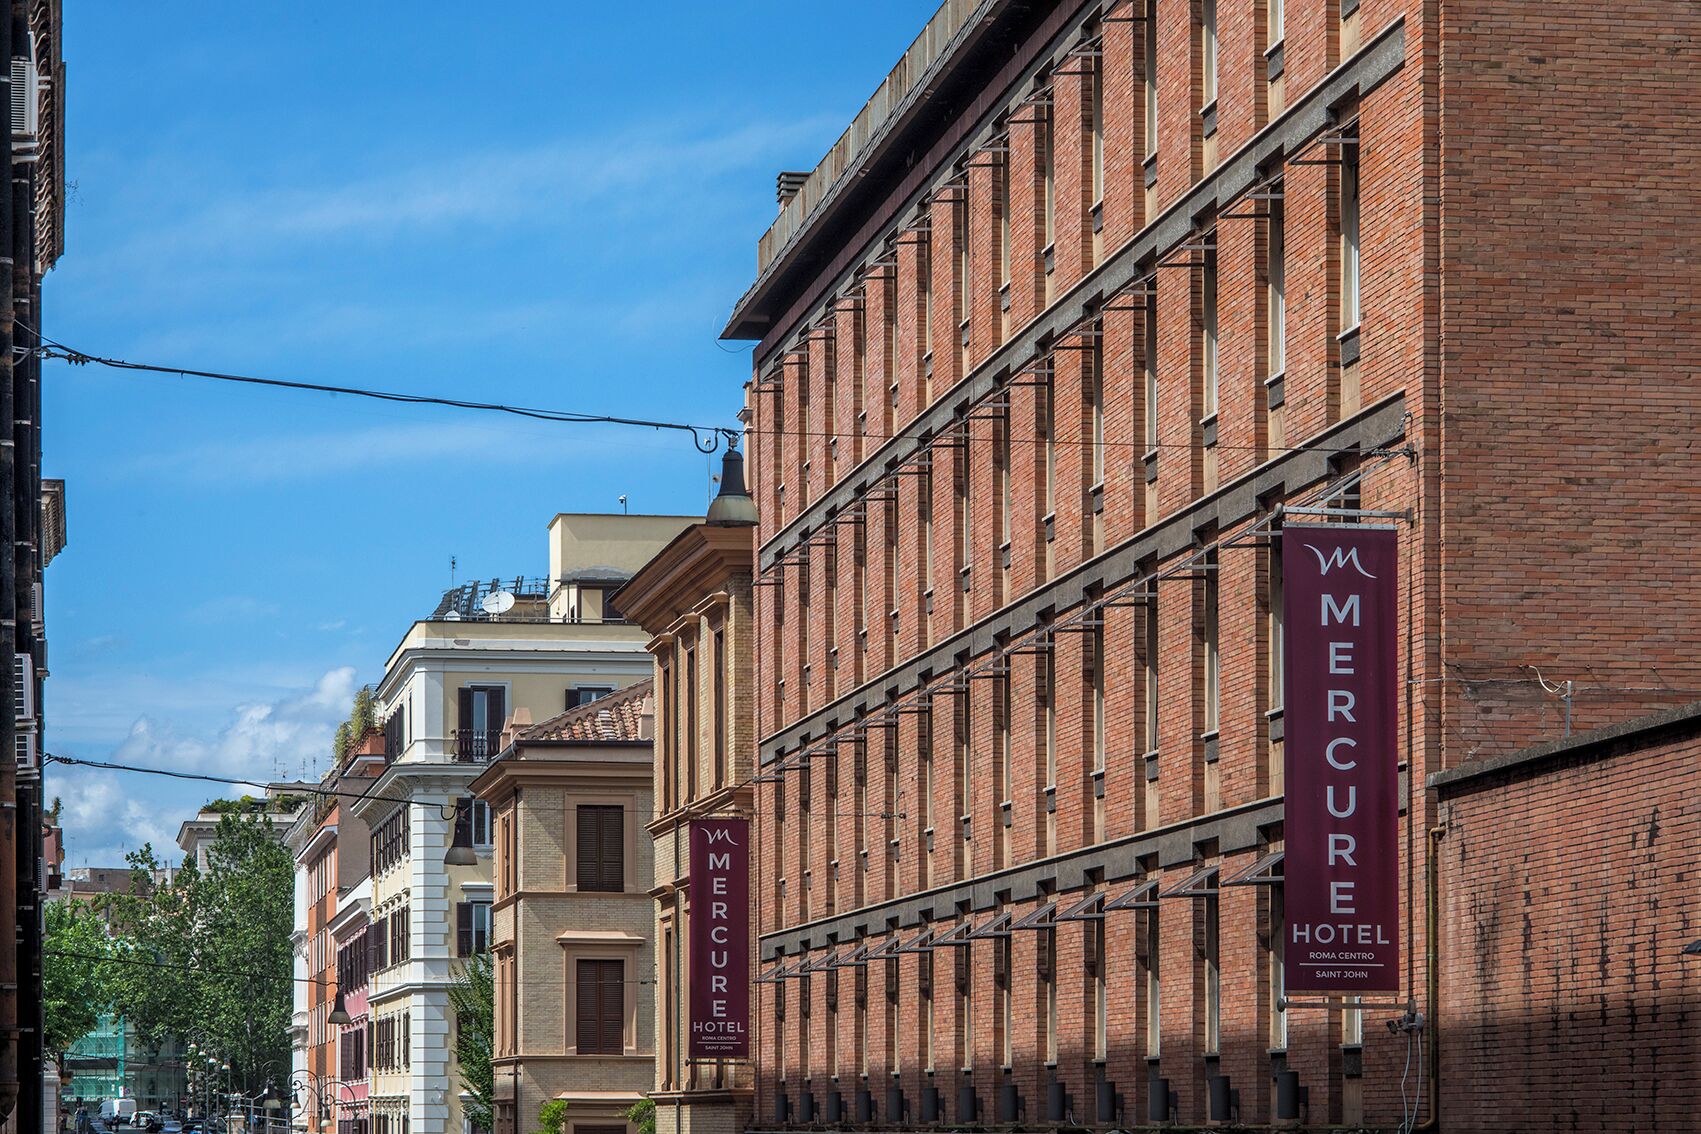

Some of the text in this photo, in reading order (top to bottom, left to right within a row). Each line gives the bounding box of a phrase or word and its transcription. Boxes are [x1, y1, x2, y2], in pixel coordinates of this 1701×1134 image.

[1320, 593, 1361, 915] MERCURE
[708, 852, 730, 1018] MERCURE
[1292, 923, 1390, 945] HOTEL
[1309, 951, 1375, 960] ROMA CENTRO
[1315, 970, 1368, 979] SAINT JOHN
[693, 1021, 745, 1033] HOTEL
